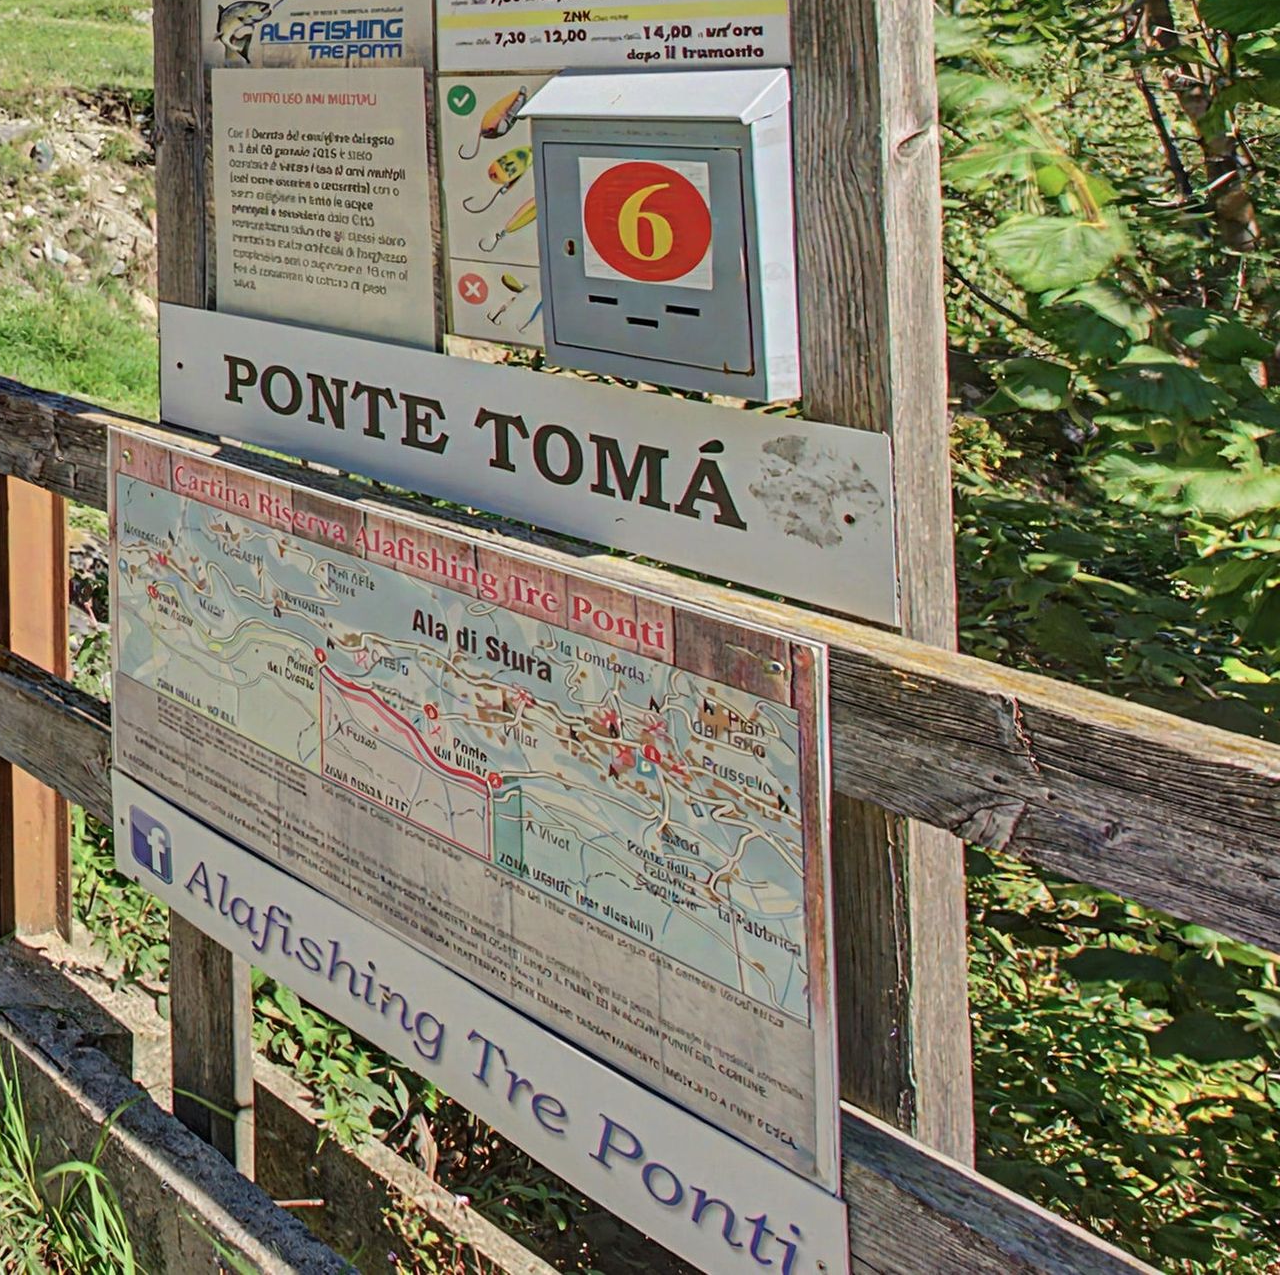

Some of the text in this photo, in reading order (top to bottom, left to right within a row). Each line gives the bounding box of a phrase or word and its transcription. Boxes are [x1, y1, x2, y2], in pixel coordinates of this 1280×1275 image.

[260, 17, 404, 42] ALA FISHING
[494, 31, 527, 48] 7,30
[543, 28, 588, 46] 12,00
[642, 24, 693, 42] 14,00
[562, 9, 592, 23] ZNK
[307, 42, 403, 60] TRE PONTI
[626, 44, 766, 64] dopo il tramonto
[617, 182, 674, 262] 6
[223, 353, 748, 532] PONTE TOMÁ
[173, 464, 250, 511] Cartina
[257, 491, 347, 544] Riserva
[355, 525, 500, 601] Alafishing
[507, 572, 560, 614] Tre
[570, 596, 667, 651] Ponti
[411, 608, 553, 683] Ala di Stura
[183, 860, 446, 1061] Alafishing
[466, 1028, 569, 1135] Tre
[588, 1112, 803, 1266] Ponti
